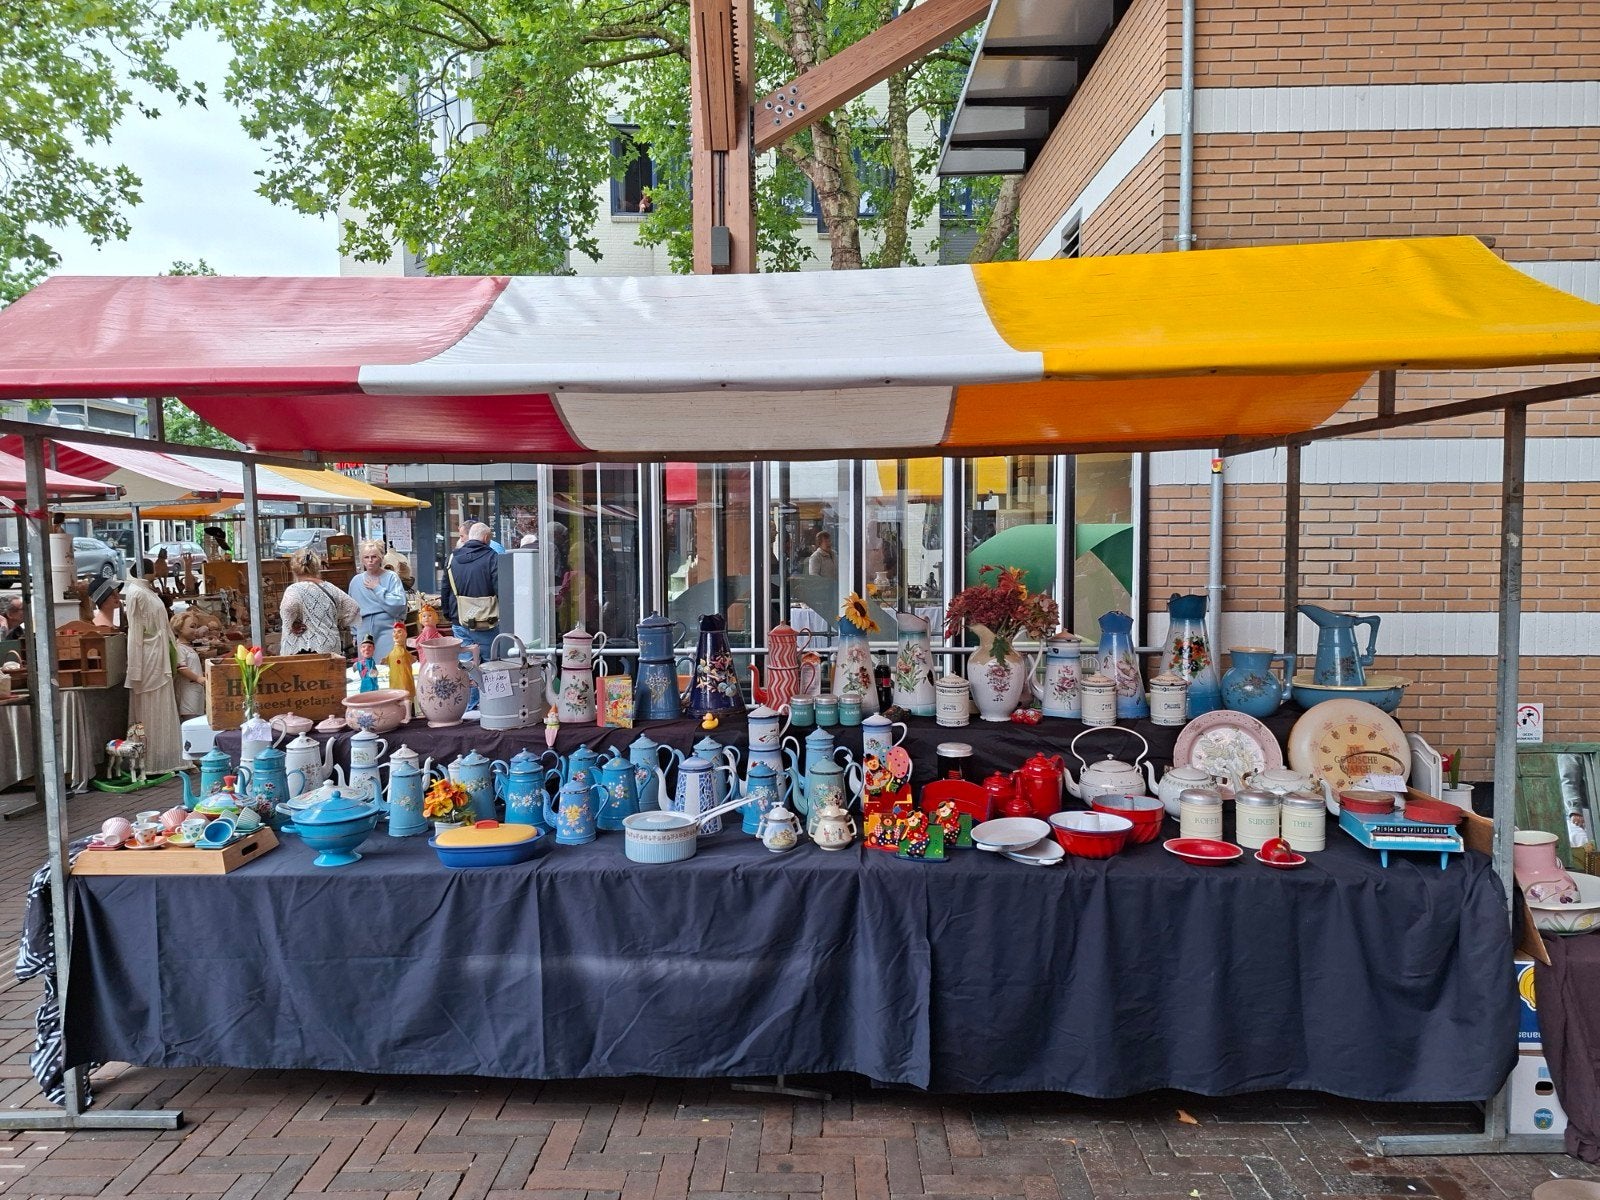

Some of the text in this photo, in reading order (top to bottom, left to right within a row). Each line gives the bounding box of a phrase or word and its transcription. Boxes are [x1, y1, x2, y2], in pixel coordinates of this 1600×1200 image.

[226, 675, 333, 697] Hineken
[1248, 817, 1276, 826] SUIKER
[1292, 819, 1313, 828] THEE
